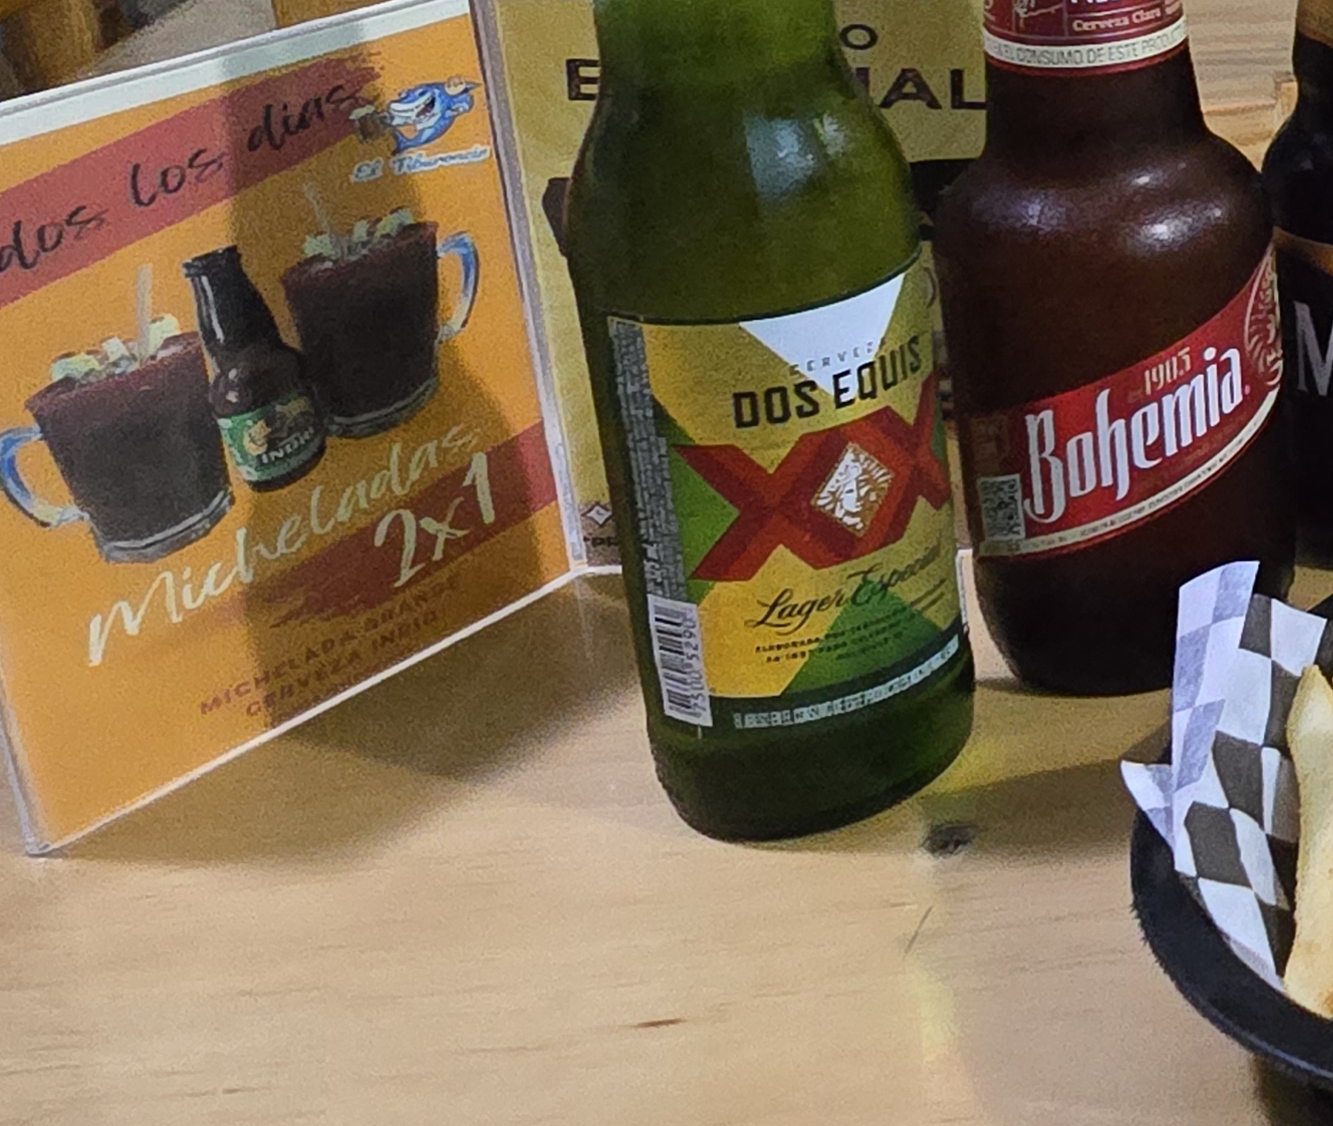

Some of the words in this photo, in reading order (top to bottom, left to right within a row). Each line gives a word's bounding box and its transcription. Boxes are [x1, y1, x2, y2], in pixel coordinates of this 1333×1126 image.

[1086, 47, 1104, 64] DE
[1107, 42, 1138, 62] ESTE
[0, 202, 110, 272] dos
[128, 148, 230, 207] los
[732, 379, 820, 429] DOS
[832, 335, 923, 411] EQUIS
[1023, 346, 1247, 524] Bohemia
[88, 424, 482, 668] Micheladas
[373, 451, 496, 589] 2x1
[744, 588, 846, 636] Lager
